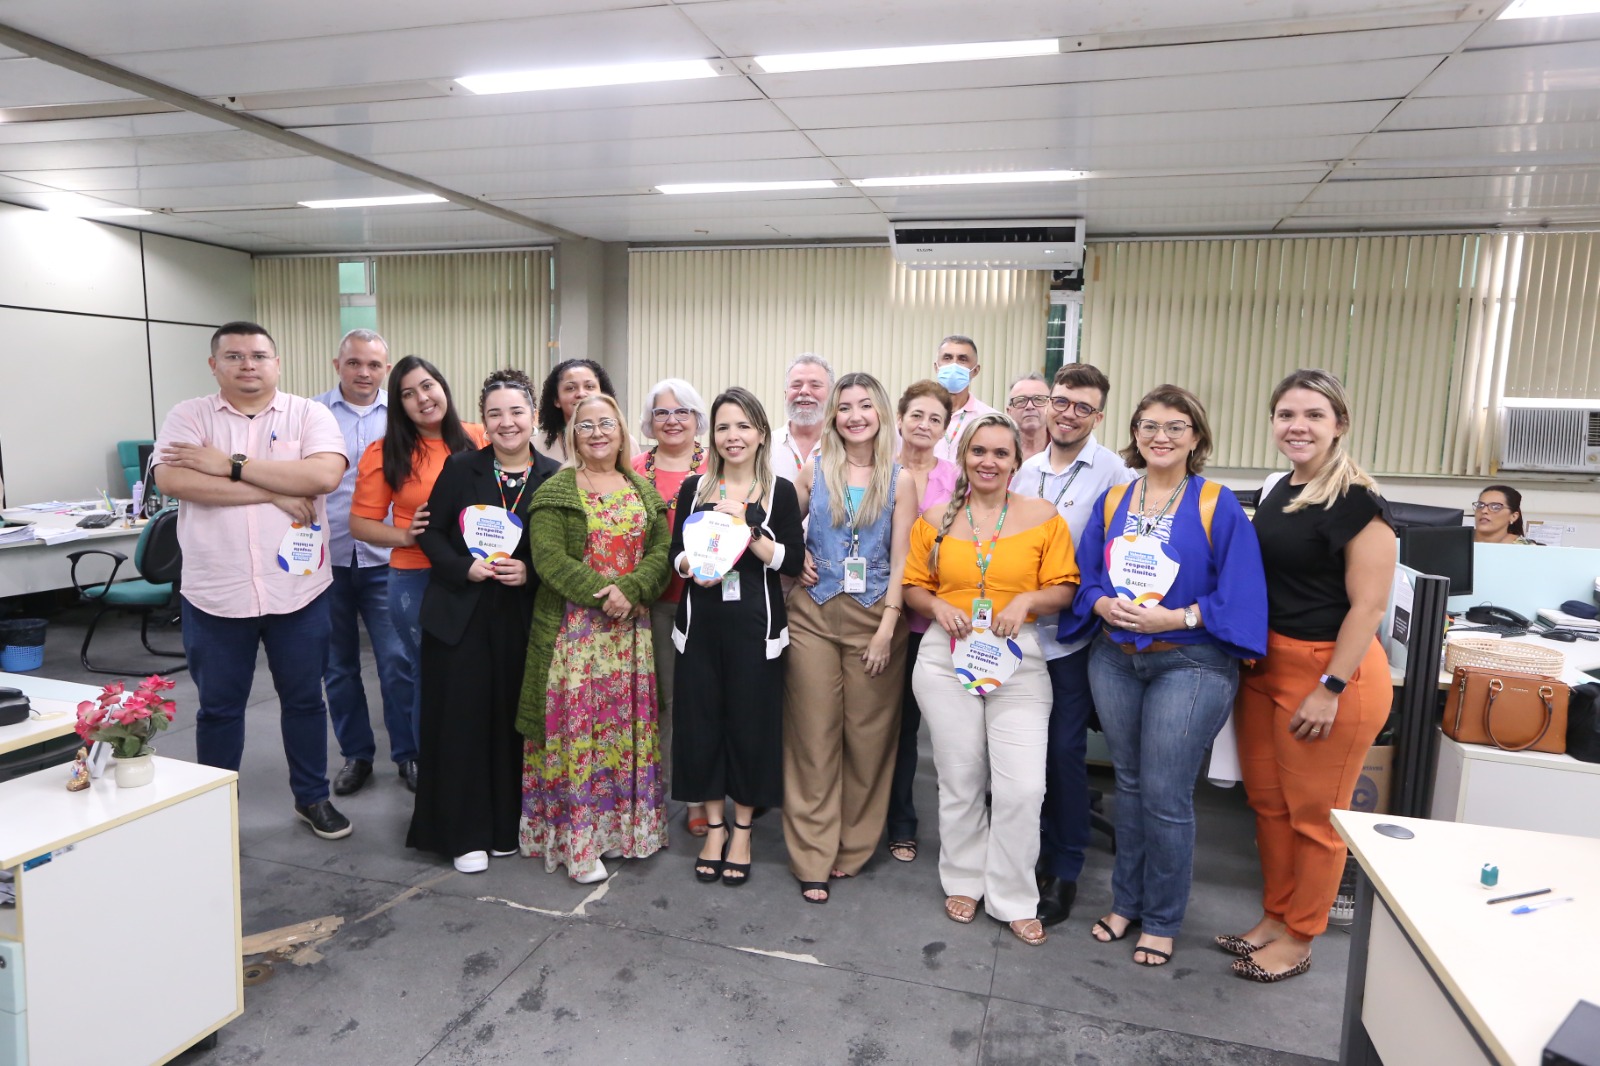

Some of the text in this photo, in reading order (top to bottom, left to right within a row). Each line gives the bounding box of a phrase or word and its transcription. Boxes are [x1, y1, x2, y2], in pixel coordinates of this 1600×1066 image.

[1125, 562, 1155, 571] respeite
[1131, 568, 1157, 578] limites
[970, 649, 998, 660] respeite
[975, 654, 999, 666] limites
